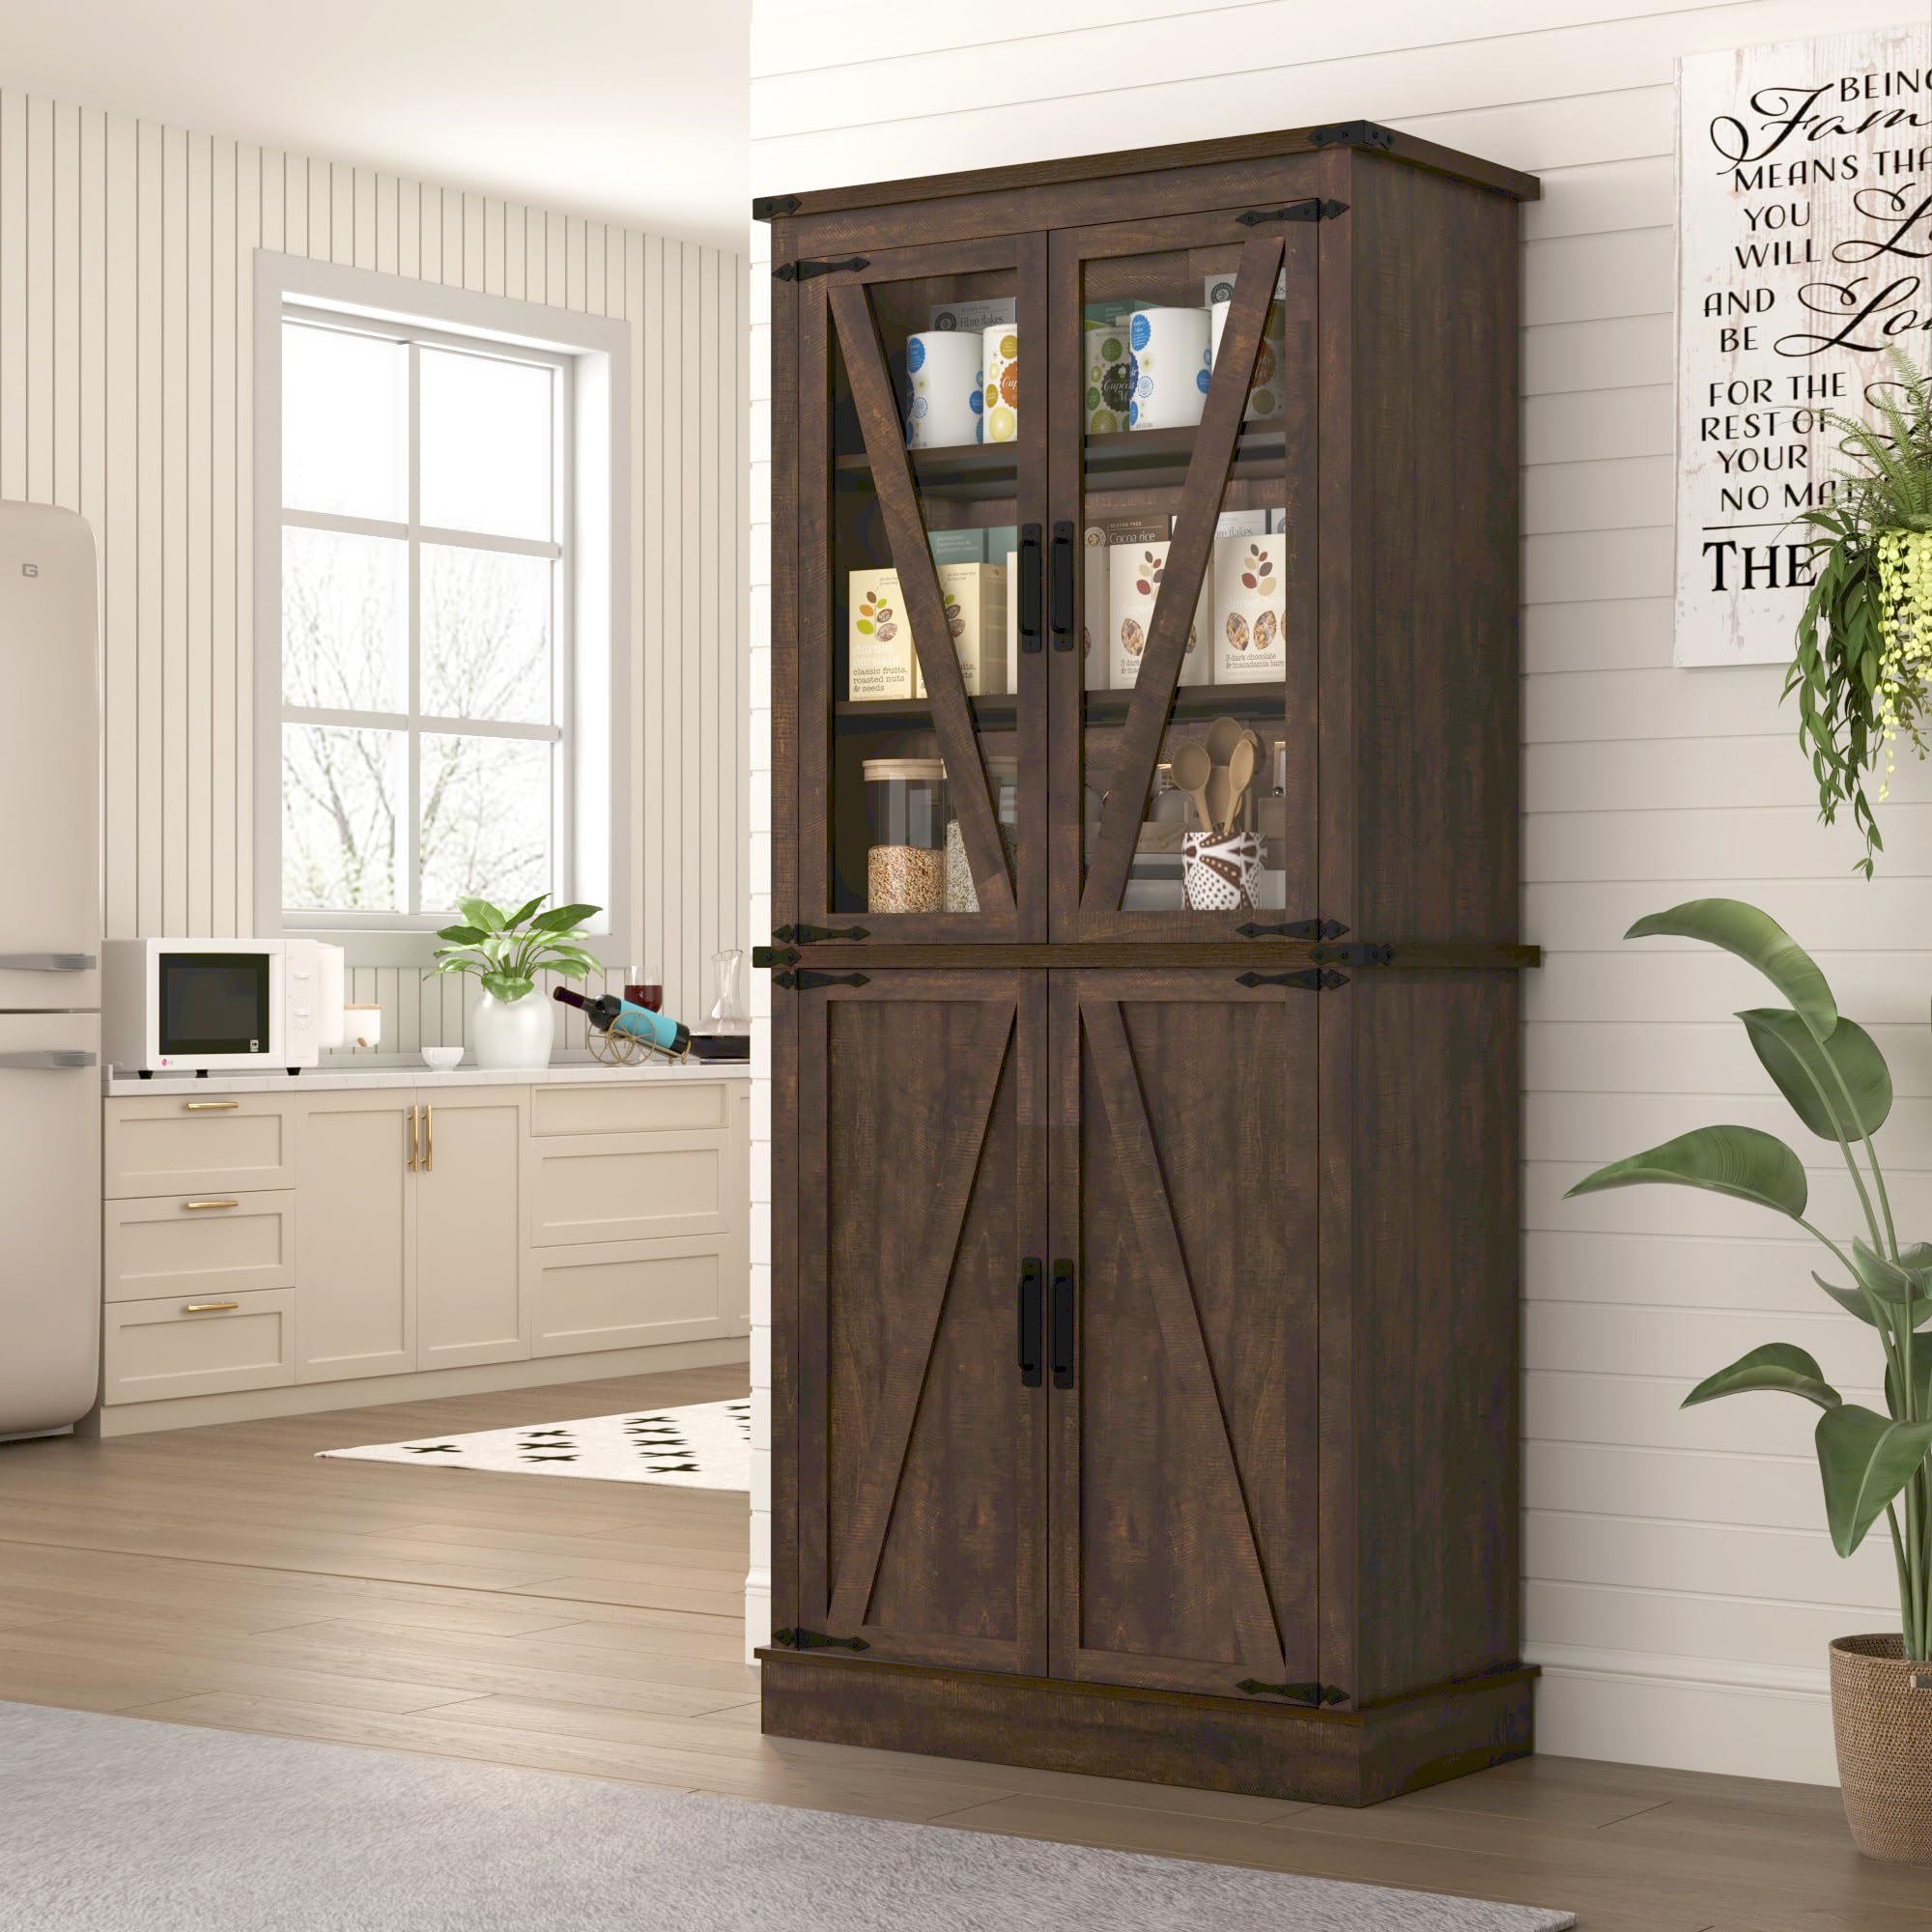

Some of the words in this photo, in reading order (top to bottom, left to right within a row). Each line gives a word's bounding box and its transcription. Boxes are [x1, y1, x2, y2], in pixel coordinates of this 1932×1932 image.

[1735, 155, 1859, 192] MEANS
[1744, 201, 1810, 231] YOU
[1735, 239, 1822, 269] WILL
[1703, 288, 1775, 317] AND
[1719, 326, 1759, 353] BE
[1709, 379, 1773, 407] FOR
[1787, 372, 1847, 400] THE
[1701, 412, 1781, 441] REST
[1792, 408, 1834, 434] OF
[1717, 444, 1807, 473] YOUR
[1720, 485, 1769, 512] NO
[1109, 532, 1137, 544] Cocoa
[1139, 530, 1155, 542] rice
[1702, 541, 1818, 592] THE
[853, 667, 881, 676] classic
[853, 675, 884, 684] roasted
[862, 684, 885, 693] seeds
